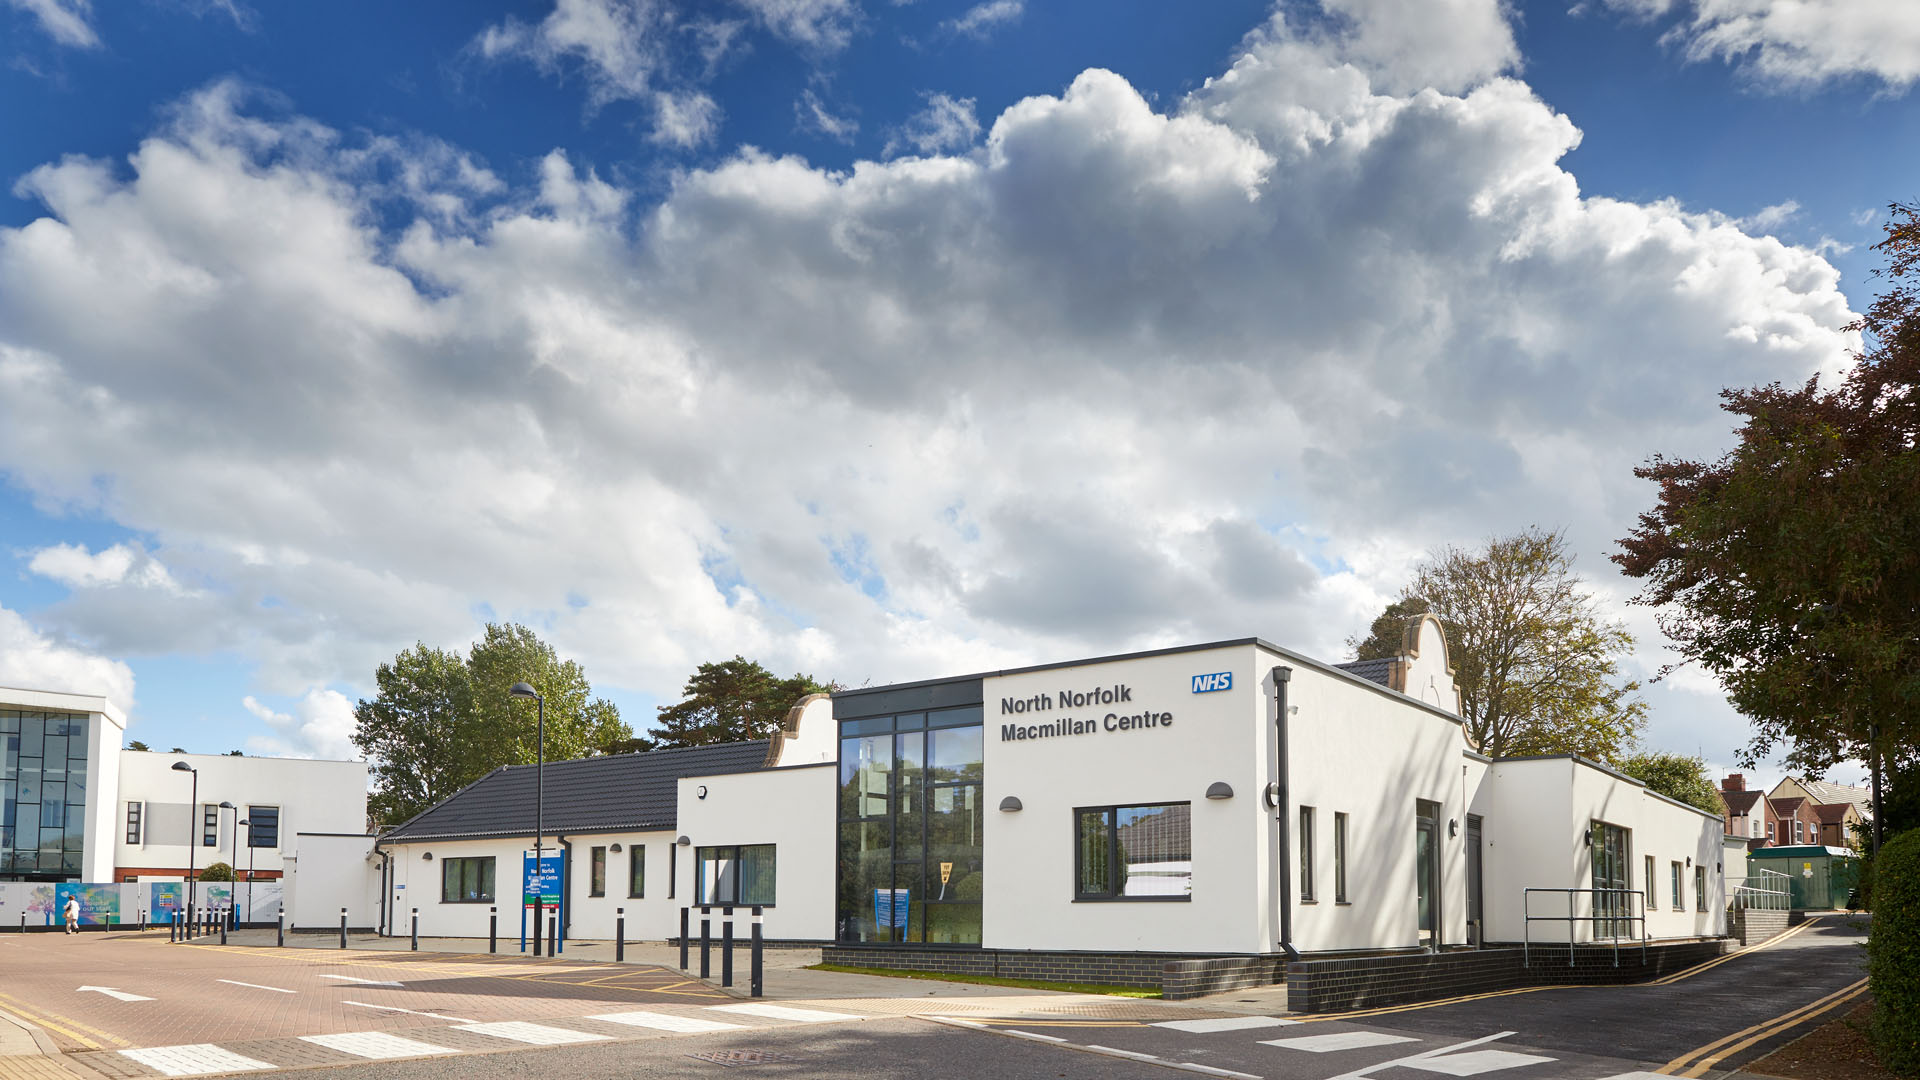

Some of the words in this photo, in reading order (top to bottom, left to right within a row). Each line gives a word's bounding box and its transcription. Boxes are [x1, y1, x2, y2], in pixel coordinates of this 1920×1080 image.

[1193, 672, 1231, 692] NHS
[1001, 693, 1052, 715] North
[1059, 684, 1132, 709] Norfolk
[1001, 717, 1097, 742] Macmillan
[1103, 710, 1173, 732] Centre
